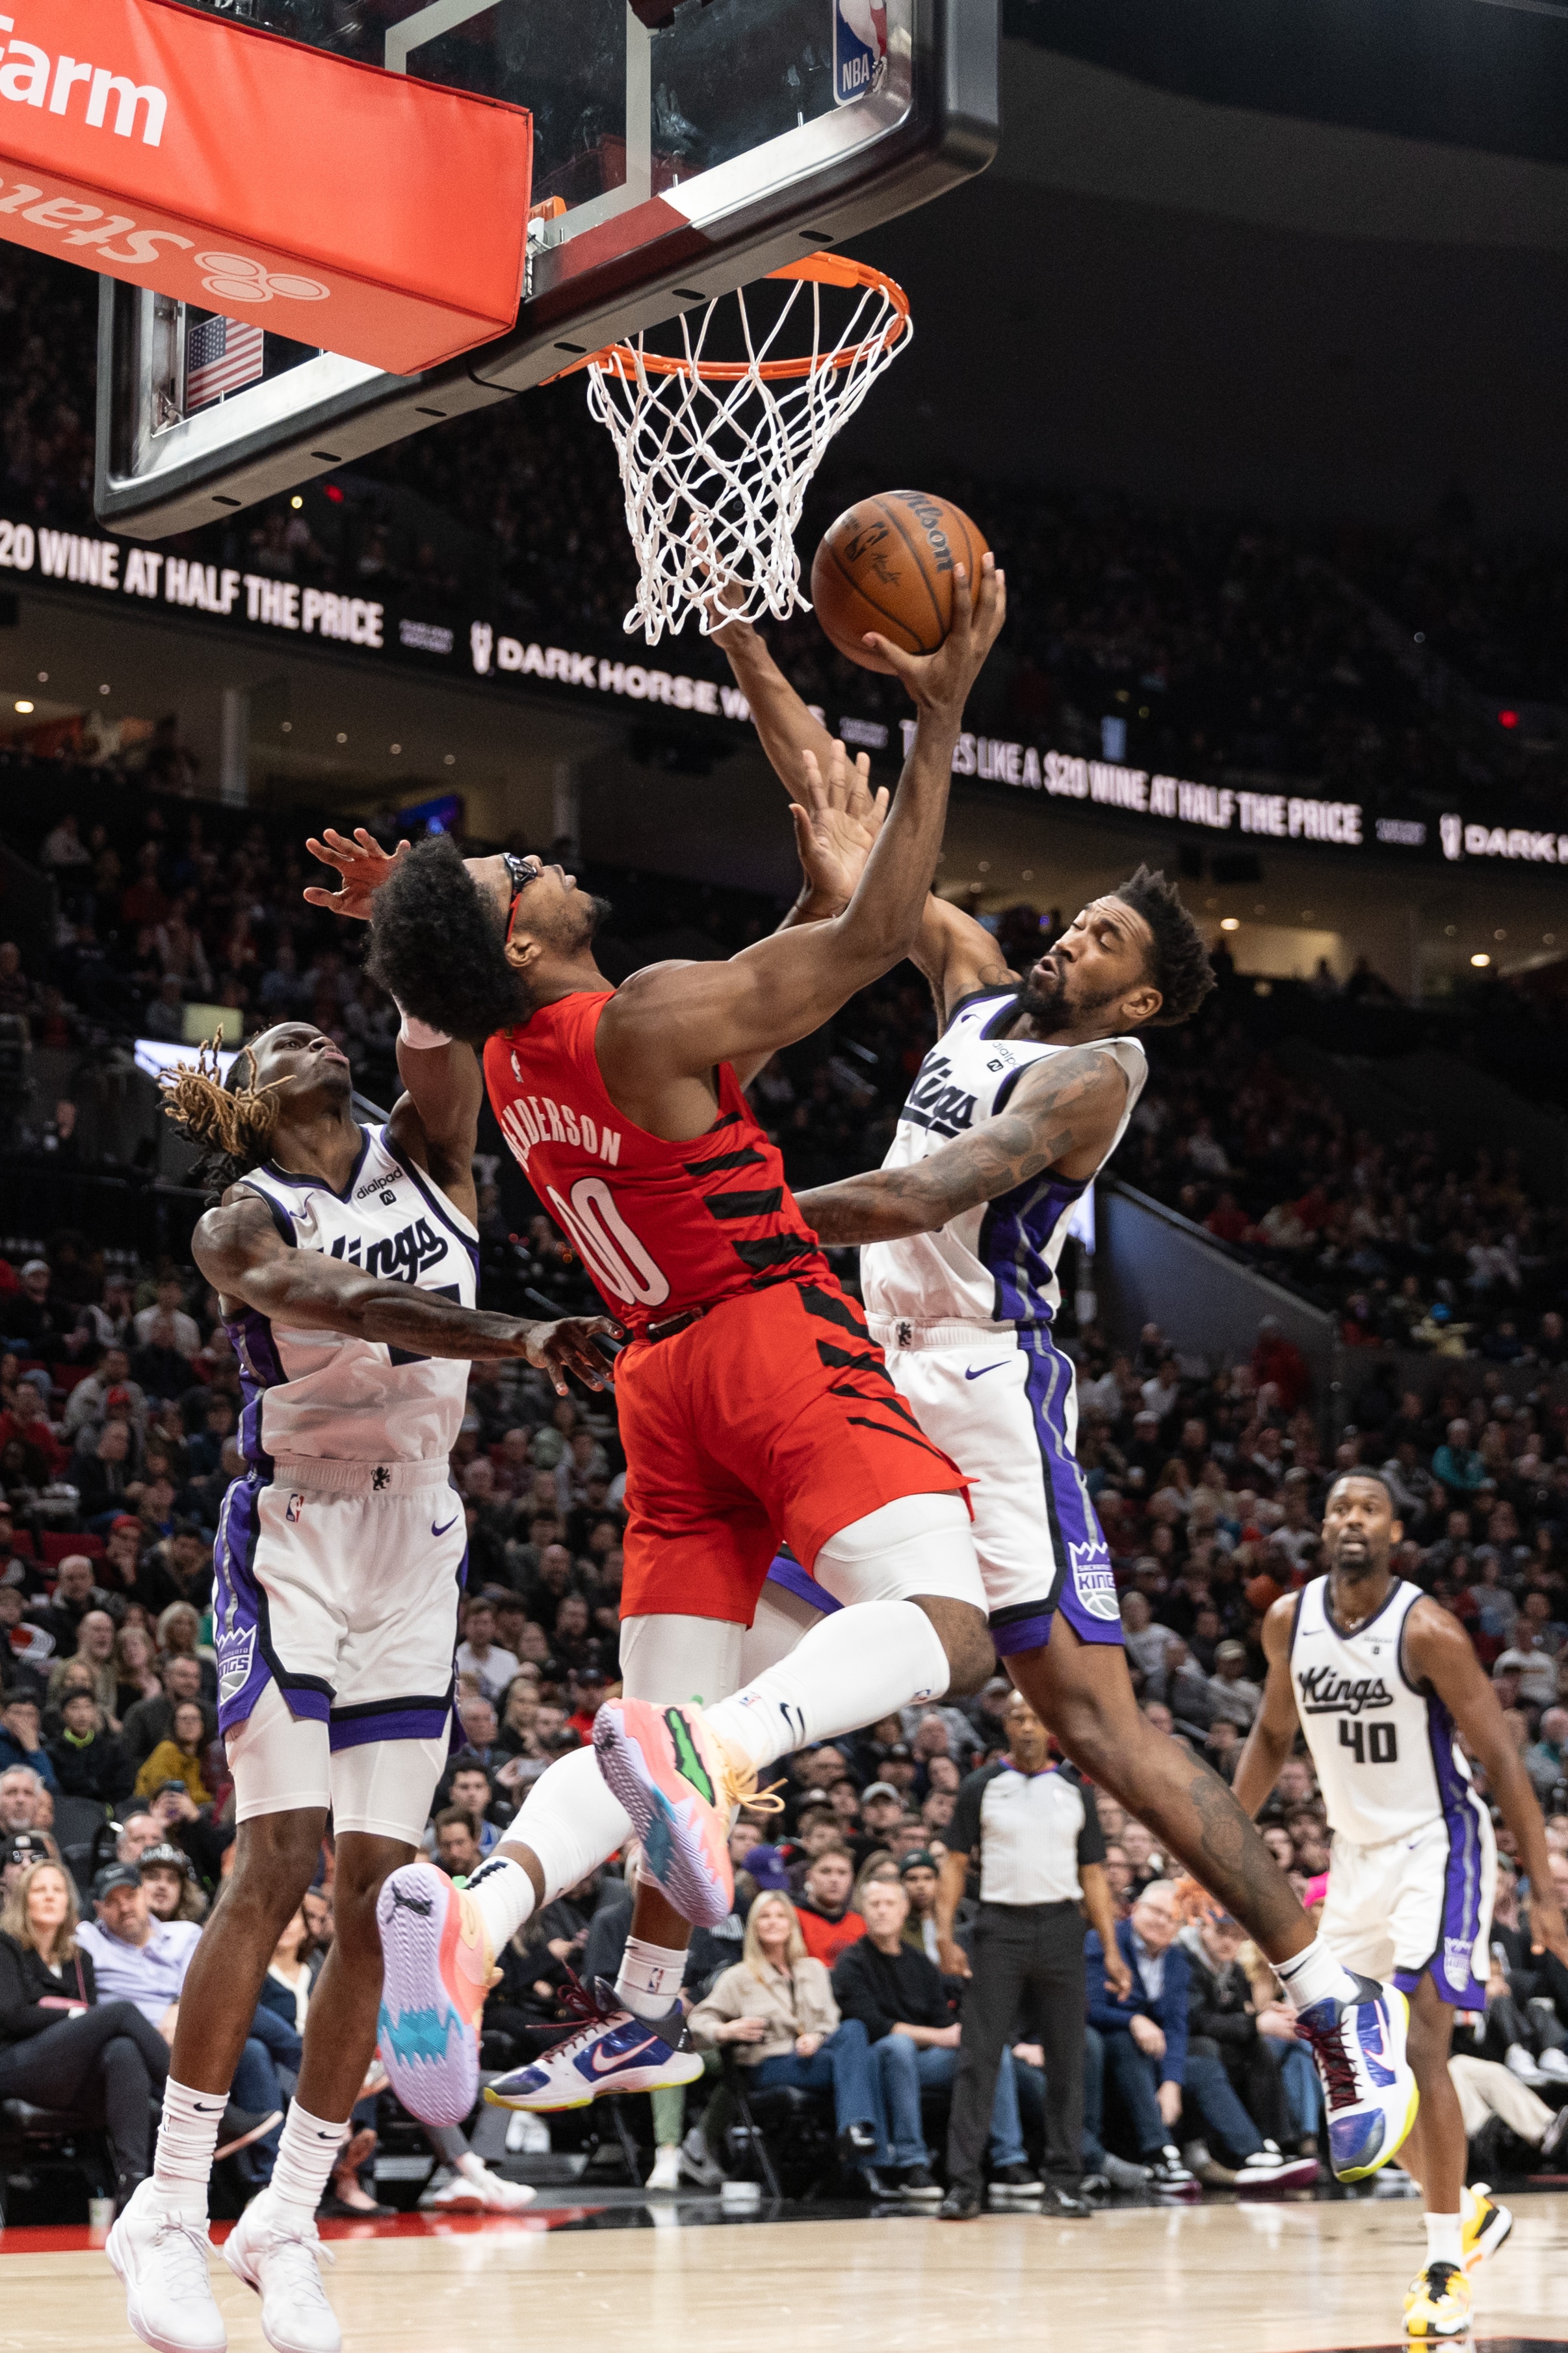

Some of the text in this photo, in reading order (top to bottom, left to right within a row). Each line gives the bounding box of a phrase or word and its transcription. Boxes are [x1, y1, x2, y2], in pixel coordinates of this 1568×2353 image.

[843, 53, 870, 92] NBA
[0, 176, 195, 264] Stat
[38, 527, 119, 590] WINE
[124, 547, 163, 599] AT
[164, 555, 239, 615] HALF
[242, 573, 299, 629] THE
[302, 587, 384, 648] PRICE
[497, 636, 597, 689] DARK
[598, 658, 718, 715] HORSE
[977, 736, 1023, 786] LIKE
[1022, 747, 1041, 790] A
[1043, 750, 1089, 799] $20
[1088, 759, 1149, 812] WINE
[1149, 774, 1178, 819] AT
[1178, 780, 1235, 829] HALF
[1235, 791, 1287, 837] THE
[1287, 797, 1363, 845] PRICE
[1465, 823, 1558, 863] DARK
[993, 1042, 1021, 1068] dialpa
[357, 1166, 402, 1199] dialpad
[546, 1177, 670, 1306] 00
[1078, 1575, 1116, 1590] KING
[1298, 1666, 1393, 1715] Kings
[1339, 1718, 1397, 1763] 40
